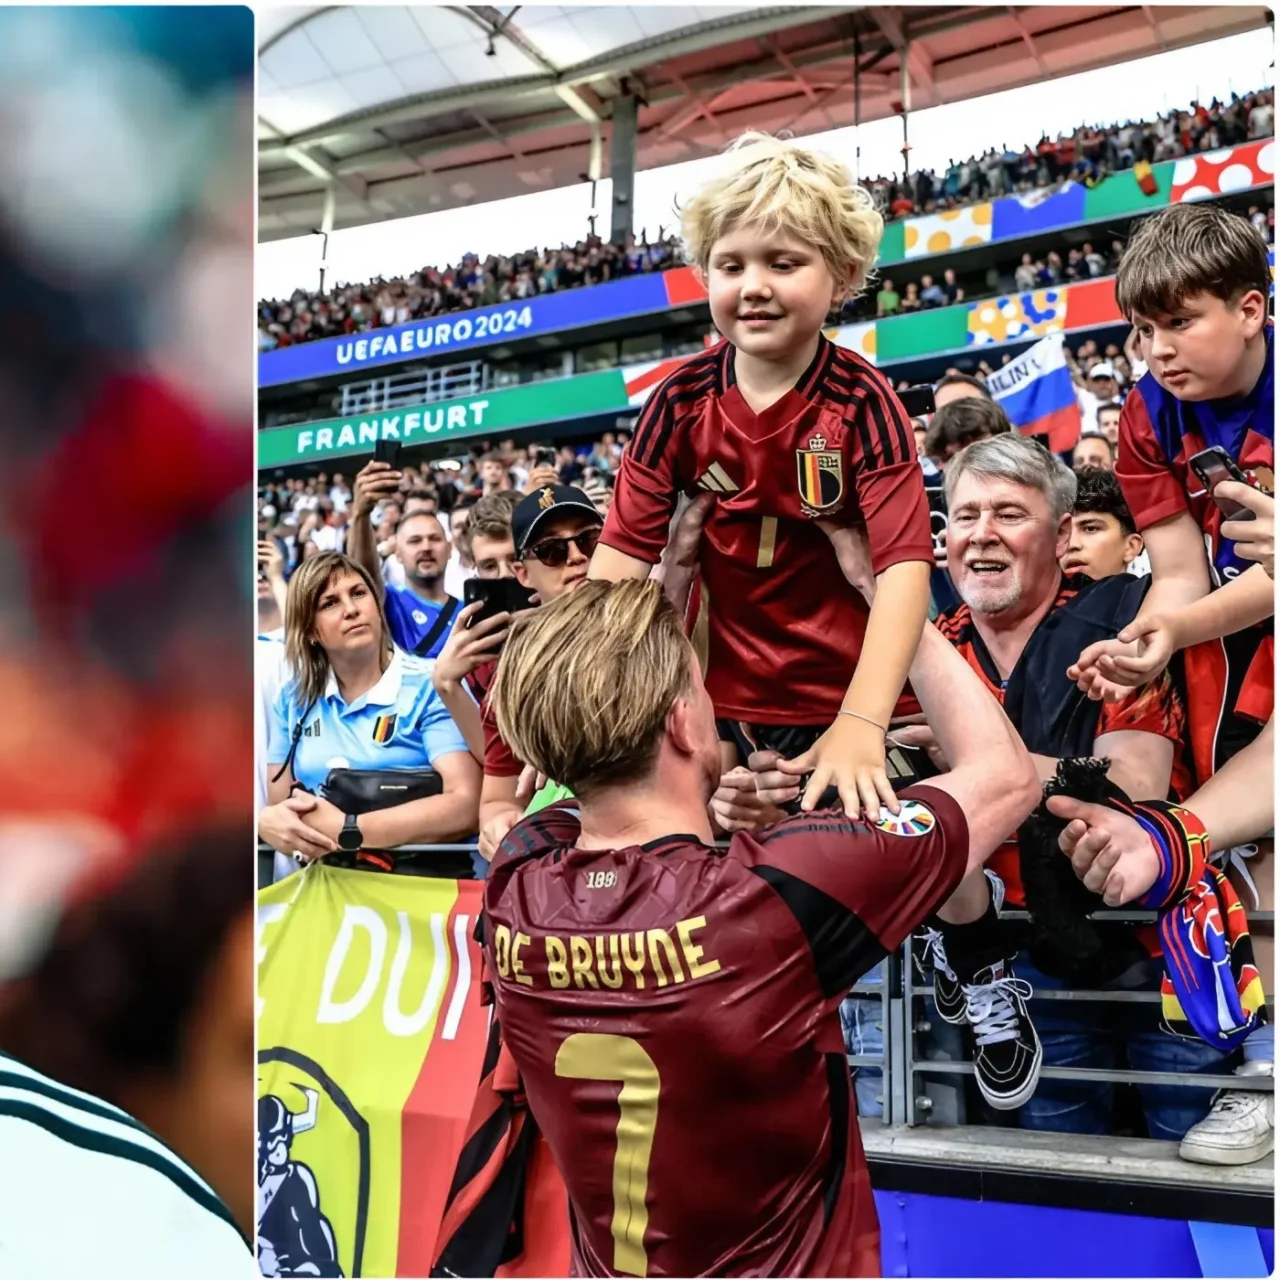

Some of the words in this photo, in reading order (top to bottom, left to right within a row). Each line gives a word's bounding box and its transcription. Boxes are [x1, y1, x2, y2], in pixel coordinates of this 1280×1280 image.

[297, 400, 489, 453] FRANKFURT
[316, 904, 480, 1040] DUI
[495, 924, 534, 986] DE
[545, 914, 721, 990] BRUYNE
[555, 1033, 661, 1278] 7
